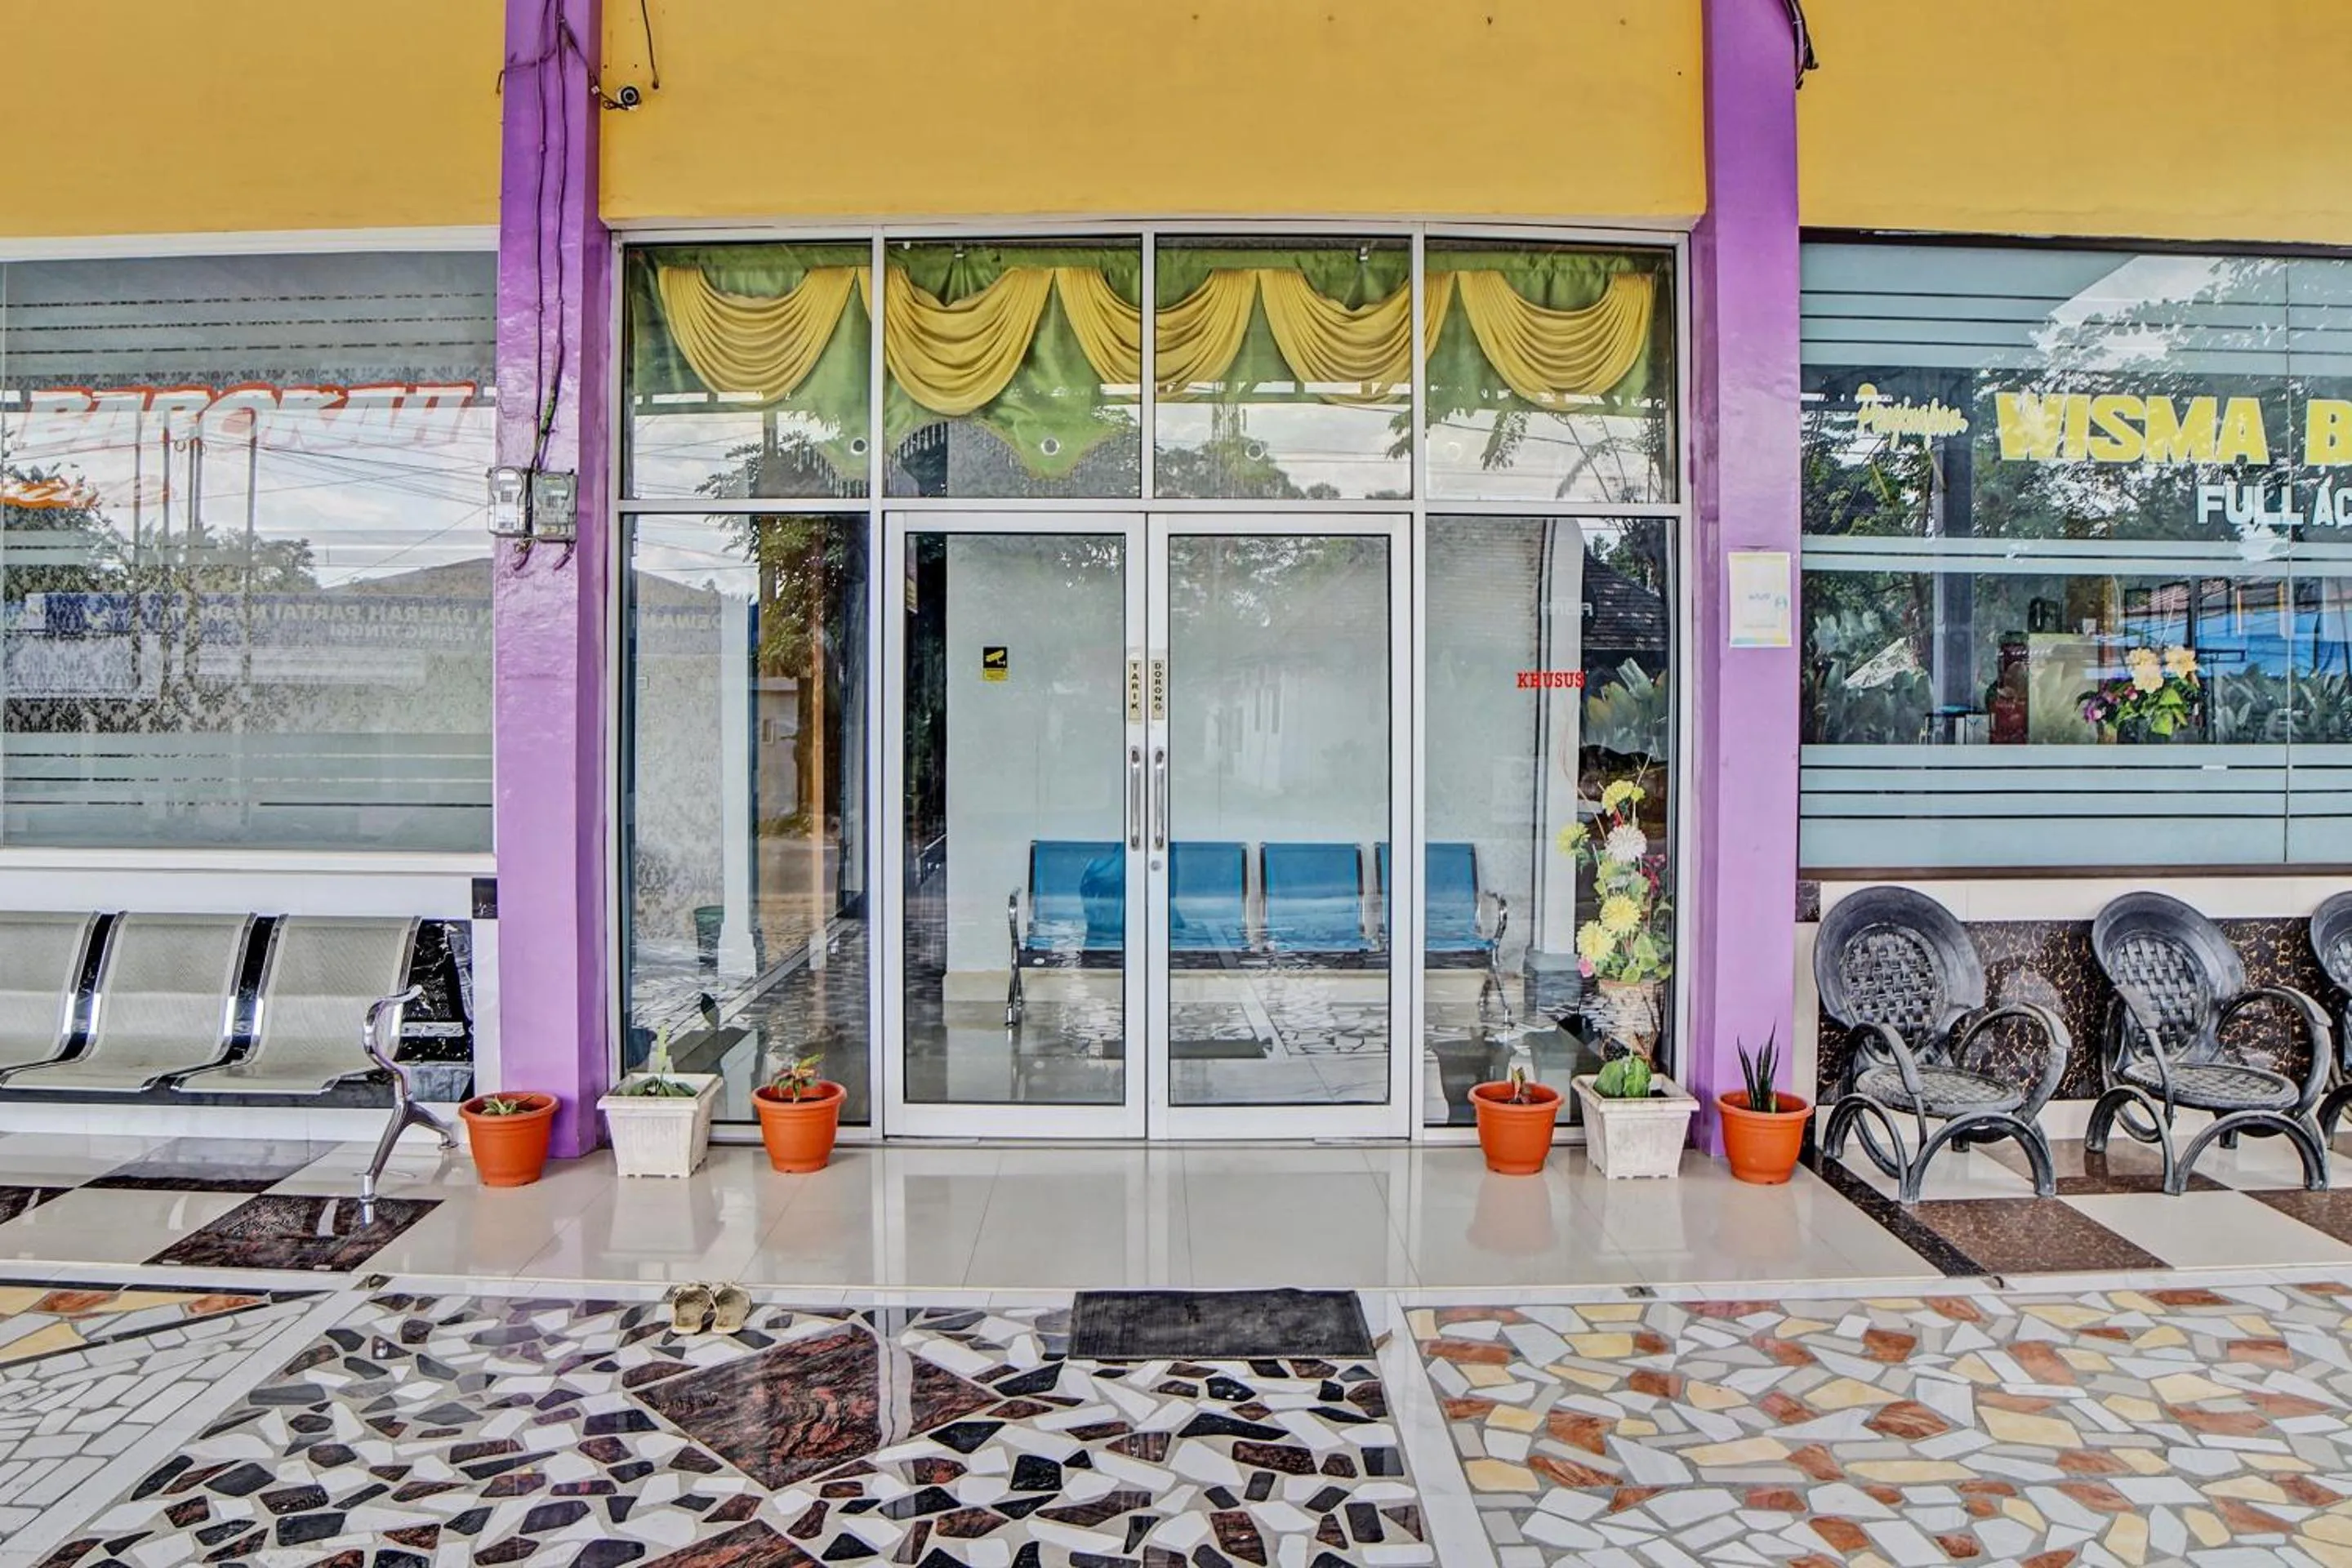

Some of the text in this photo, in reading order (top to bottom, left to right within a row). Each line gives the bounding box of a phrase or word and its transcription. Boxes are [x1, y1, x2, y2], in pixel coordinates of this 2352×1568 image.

[1995, 392, 2270, 465] WISMA
[2197, 485, 2305, 526] FULL
[1131, 662, 1139, 710] TARIK
[1154, 662, 1163, 711] DORONG
[1516, 670, 1586, 688] KHUSUS
